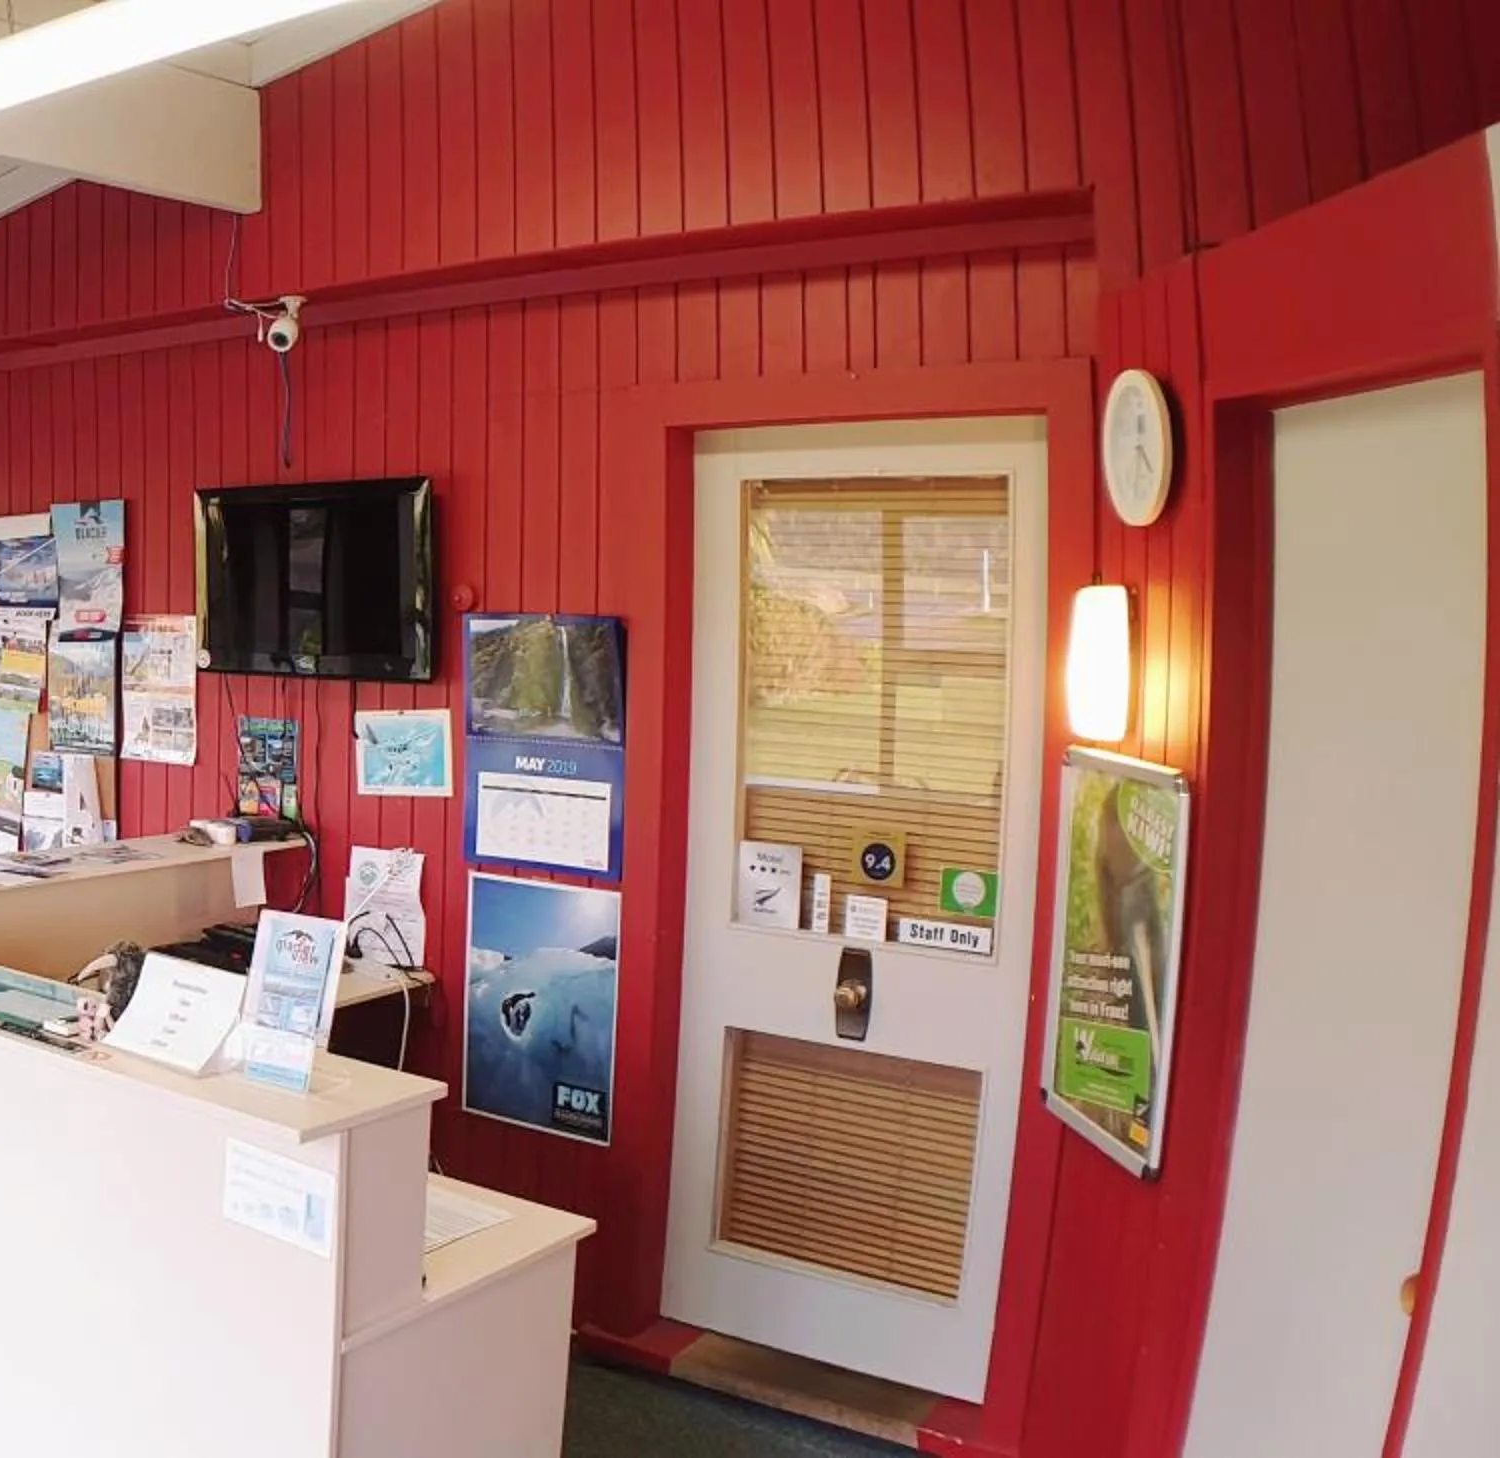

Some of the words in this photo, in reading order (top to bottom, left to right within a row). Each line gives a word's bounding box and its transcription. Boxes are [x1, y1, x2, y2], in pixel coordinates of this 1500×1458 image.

[514, 755, 546, 772] MAY
[547, 759, 577, 774] 2019
[865, 853, 891, 871] 9.4
[910, 923, 945, 941] Staff
[949, 929, 979, 949] Only
[1109, 976, 1133, 998] right
[1089, 999, 1098, 1017] in
[557, 1085, 600, 1116] FOX
